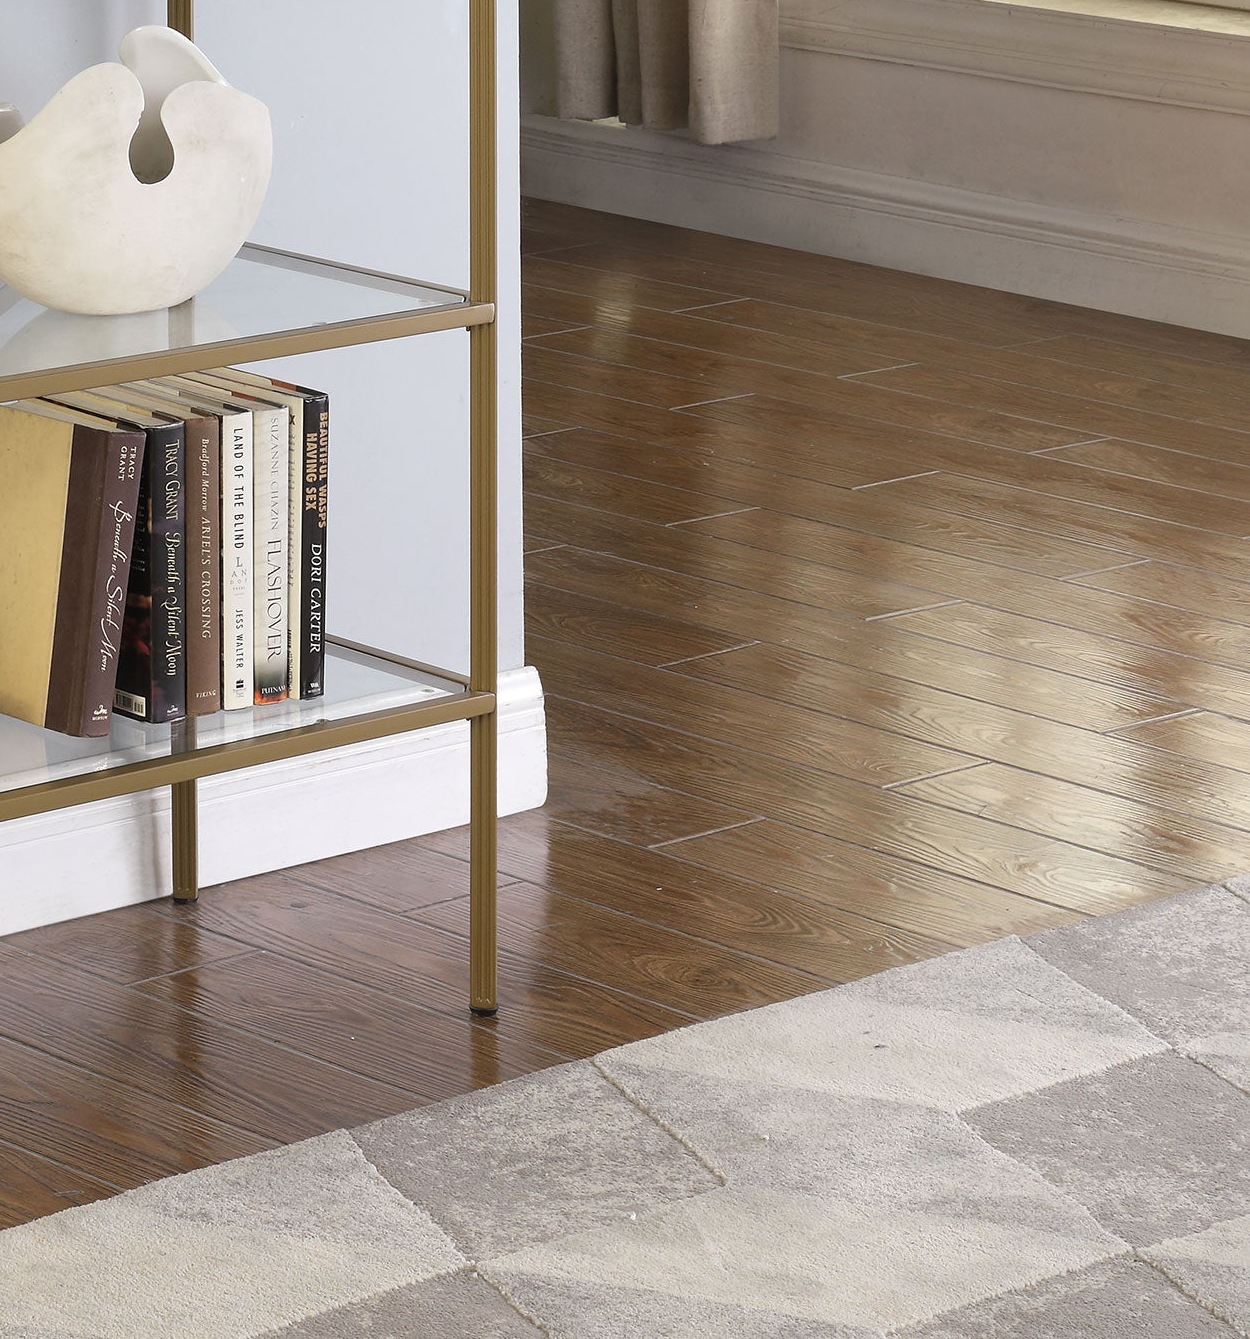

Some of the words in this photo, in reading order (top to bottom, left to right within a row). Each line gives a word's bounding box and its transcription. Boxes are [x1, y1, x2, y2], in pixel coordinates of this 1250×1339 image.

[165, 439, 180, 477] TRACY
[199, 438, 210, 476] Bradford
[232, 427, 244, 459] LAND
[269, 417, 278, 477] SUZANNE
[305, 433, 316, 484] HAVING
[318, 411, 328, 480] BEAUTIFUL
[117, 446, 127, 482] GRANT
[128, 446, 137, 481] TRACY
[233, 464, 244, 479] OF
[165, 480, 181, 520] GRANT
[201, 478, 210, 512] Morrow
[233, 485, 245, 508] THE
[269, 481, 278, 530] CHAZIN
[305, 486, 316, 511] SEX
[318, 483, 326, 528] WASPS
[109, 501, 132, 563] Beneath
[201, 516, 211, 566] ARIEL'S
[233, 514, 245, 550] BLIND
[111, 564, 118, 575] a
[165, 532, 181, 584] Beneath
[311, 543, 321, 583] DORI
[106, 575, 123, 629] Silent
[168, 585, 174, 593] a
[201, 571, 212, 639] CROSSING
[266, 539, 283, 662] FLASHOVER
[160, 593, 182, 638] Silent
[235, 609, 243, 630] JESS
[309, 588, 321, 653] CARTER
[101, 618, 117, 672] Moon
[166, 640, 183, 677] Moon
[236, 633, 244, 669] WALTER
[196, 689, 217, 698] VIKING
[261, 685, 286, 694] PUTNAM
